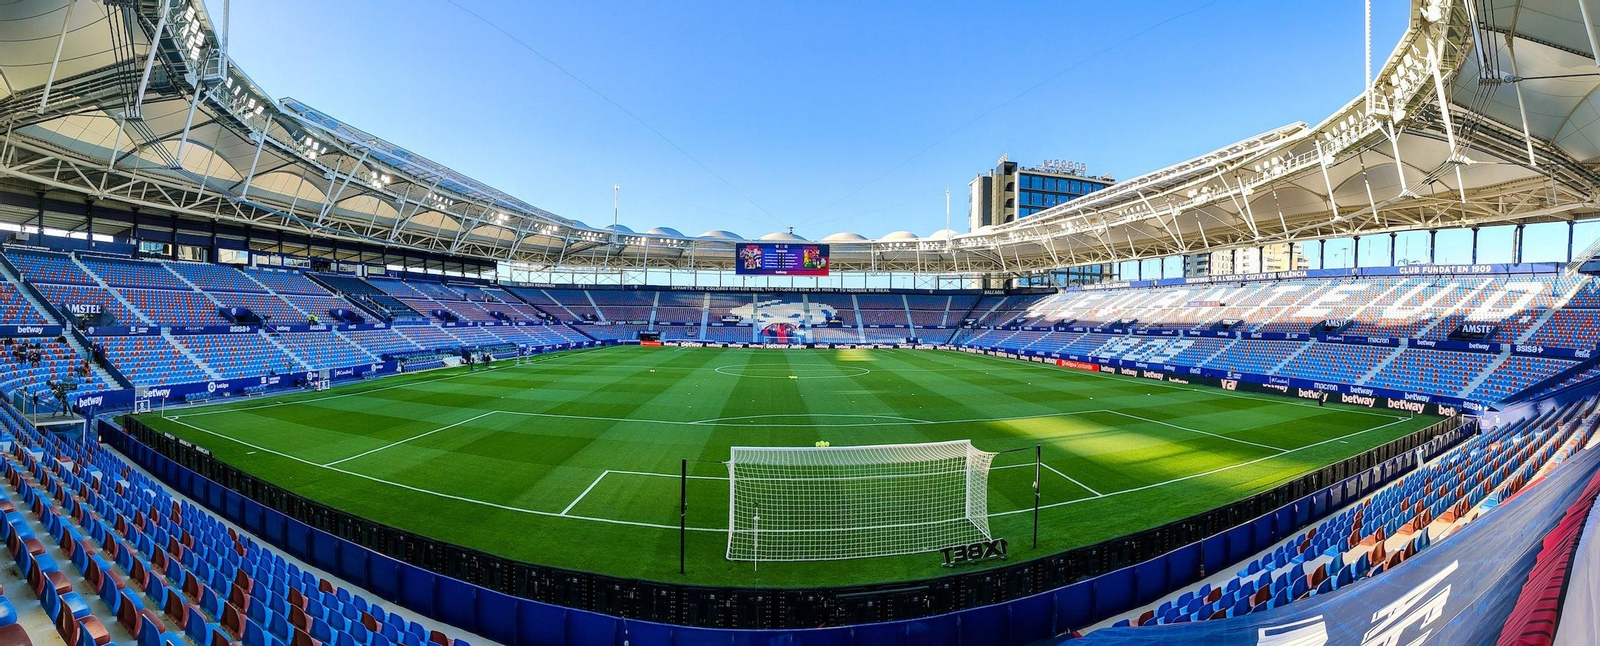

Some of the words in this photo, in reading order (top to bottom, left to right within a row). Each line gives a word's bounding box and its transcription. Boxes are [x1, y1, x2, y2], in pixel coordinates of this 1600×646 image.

[1422, 266, 1455, 274] FUNDAT
[17, 325, 44, 334] betway
[1417, 339, 1436, 348] betway
[1468, 343, 1490, 351] betway
[1516, 345, 1538, 353] asisa
[1101, 365, 1115, 374] betway
[1136, 361, 1149, 369] betway
[1164, 364, 1176, 372] betway
[1121, 368, 1138, 377] betway
[1144, 370, 1163, 380] betway
[1314, 382, 1338, 391] macron
[1350, 385, 1373, 396] betway
[143, 389, 171, 398] betway
[1298, 388, 1328, 402] betwy
[1405, 392, 1430, 402] betway
[79, 395, 104, 408] betway
[1342, 393, 1375, 408] betway
[1388, 398, 1425, 414] betway
